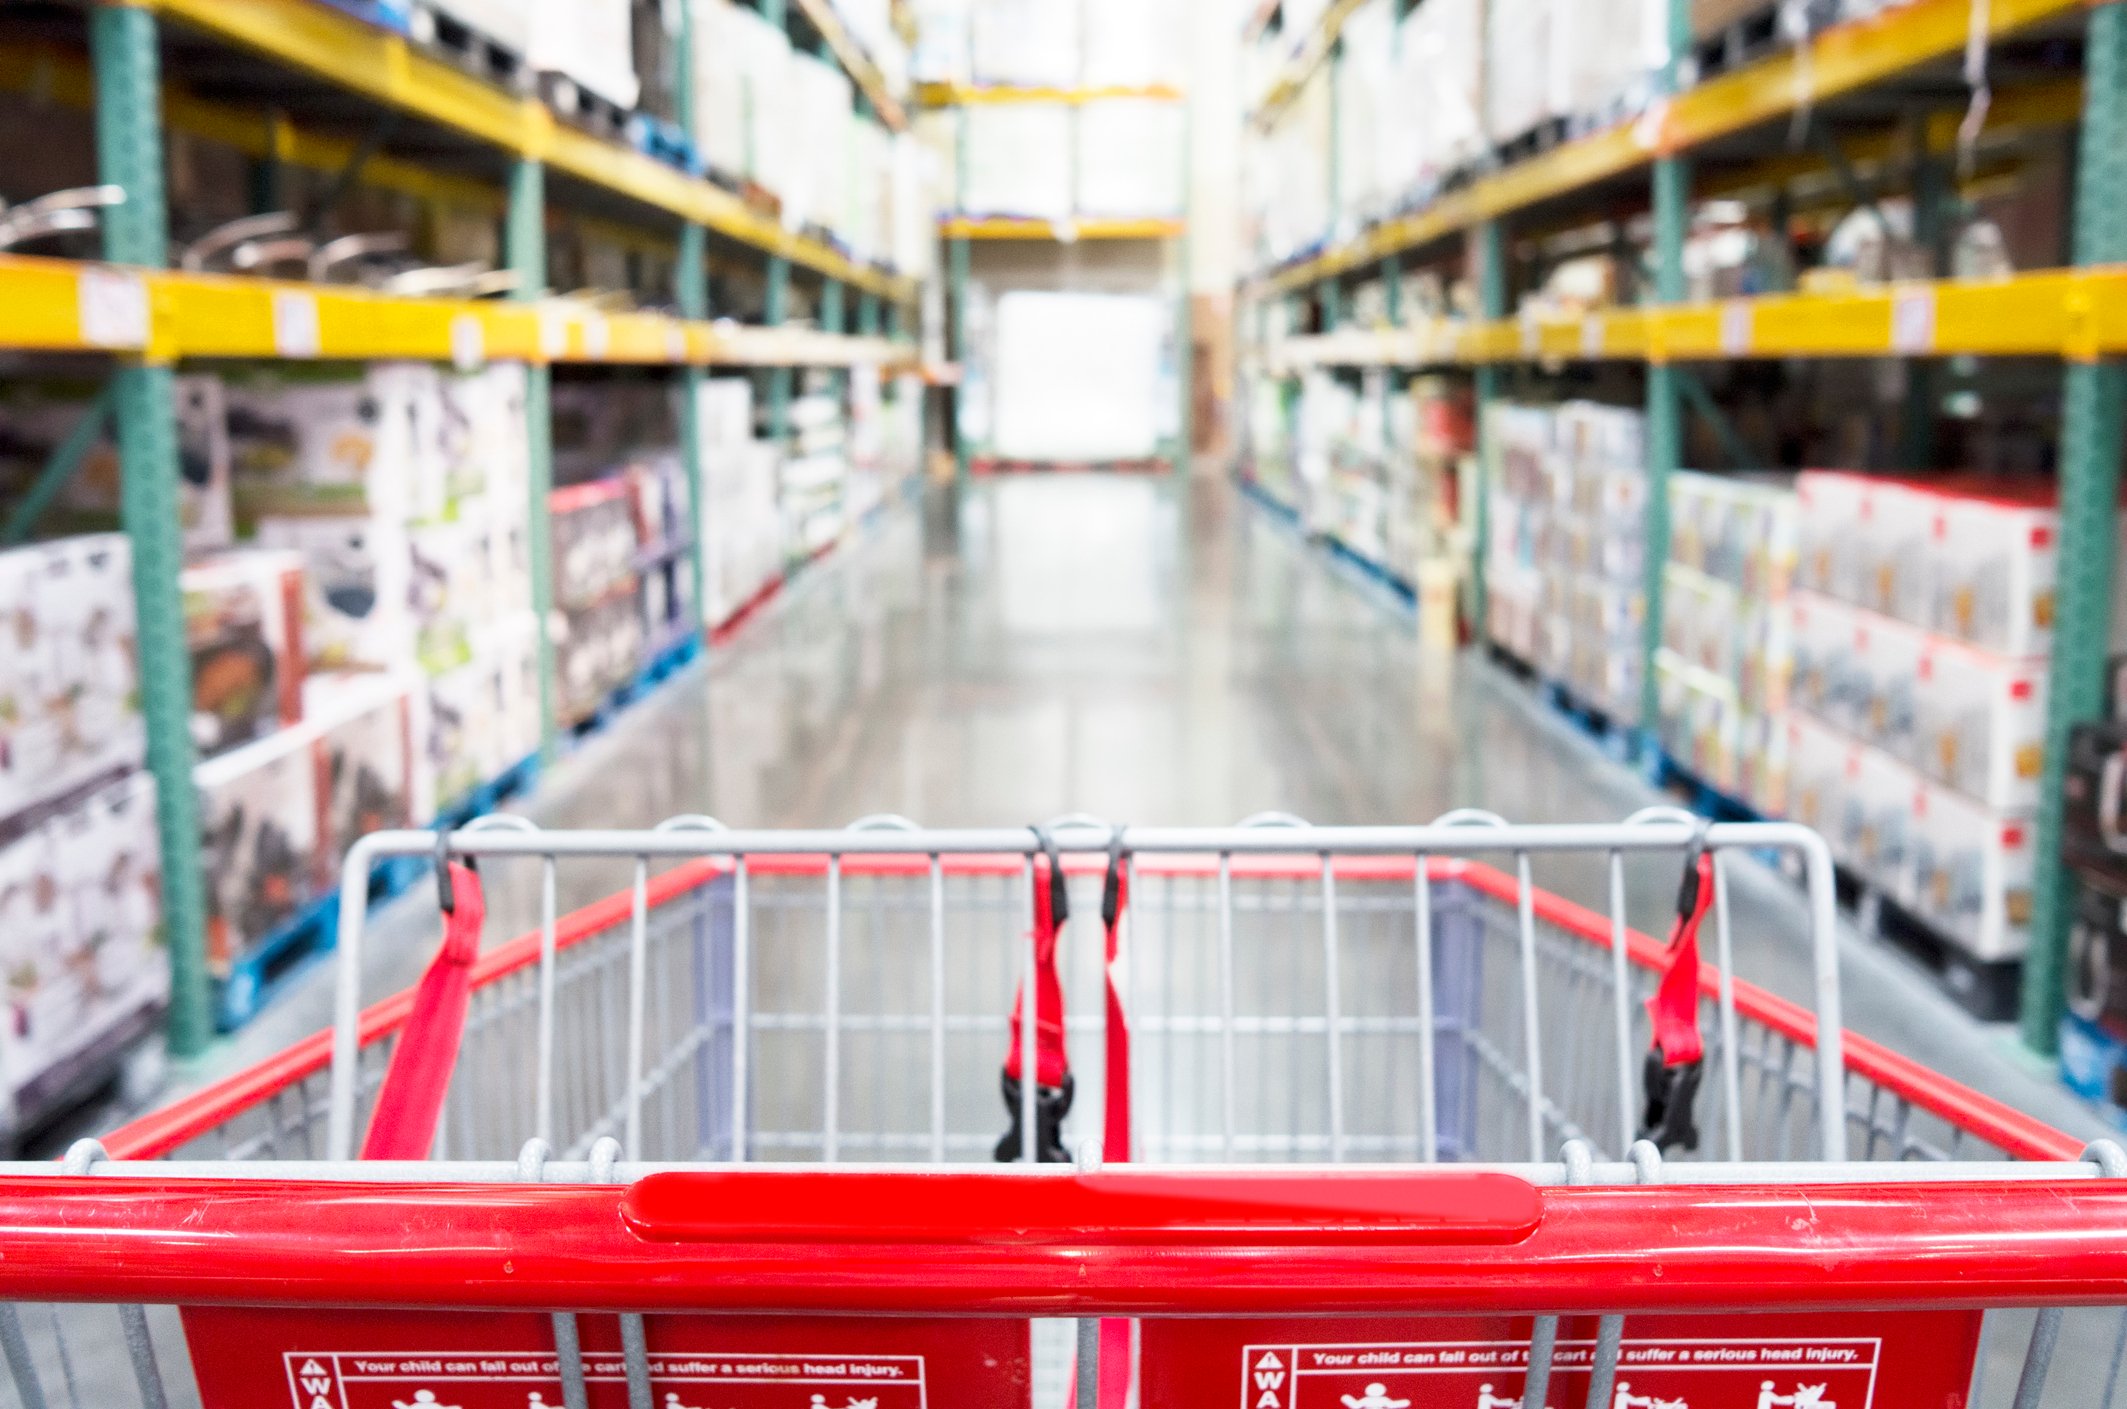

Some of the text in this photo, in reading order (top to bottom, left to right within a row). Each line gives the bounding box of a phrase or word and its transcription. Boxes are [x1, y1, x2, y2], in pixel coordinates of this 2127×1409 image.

[1312, 1352, 1355, 1366] Your
[1357, 1351, 1401, 1365] child
[1403, 1352, 1436, 1364] can
[1438, 1350, 1466, 1363] fall
[1467, 1350, 1497, 1363] out
[1500, 1350, 1519, 1362] of
[1553, 1349, 1587, 1362] cart
[1625, 1348, 1676, 1362] suffer
[1677, 1350, 1691, 1361] a
[1692, 1348, 1757, 1362] serious
[1760, 1347, 1803, 1361] head
[1806, 1347, 1859, 1363] injury.
[354, 1360, 396, 1373] Your
[399, 1360, 442, 1373] child
[445, 1362, 477, 1373] can
[480, 1360, 506, 1373] fall
[509, 1361, 539, 1373] out
[667, 1361, 717, 1374] suffer
[720, 1363, 732, 1374] a
[735, 1363, 800, 1375] serious
[803, 1363, 846, 1375] head
[849, 1363, 904, 1378] injury.
